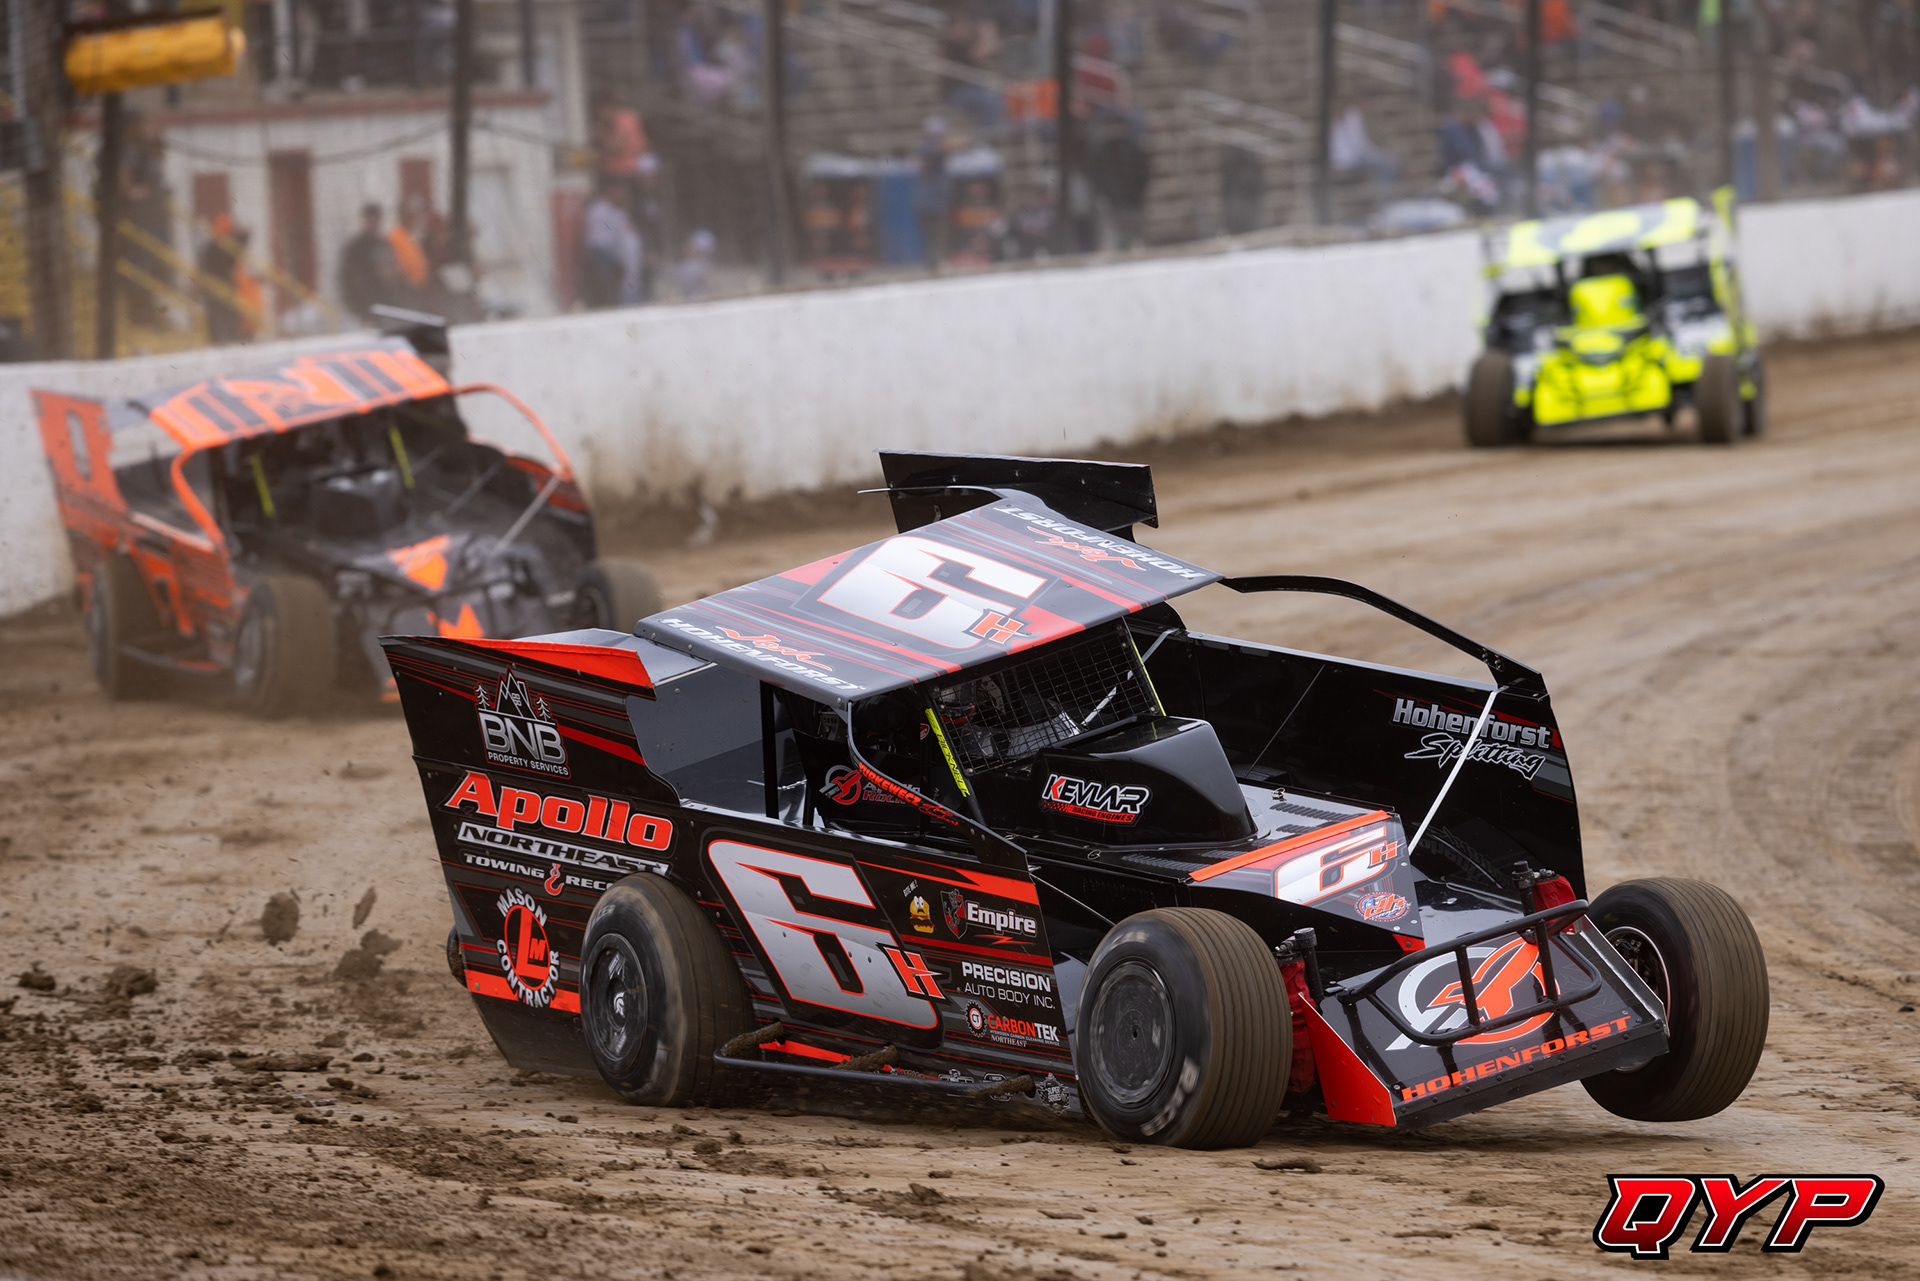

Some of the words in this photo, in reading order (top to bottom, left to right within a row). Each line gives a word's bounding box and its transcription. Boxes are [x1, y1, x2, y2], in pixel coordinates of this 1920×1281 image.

[993, 506, 1207, 579] HOHENFORST
[659, 618, 860, 691] HOHENFORST
[479, 713, 567, 765] BNB
[1392, 697, 1551, 749] Hohenforst
[487, 751, 528, 768] PROPERTY
[529, 760, 570, 777] SERVICES
[444, 769, 673, 851] Apollo
[1041, 773, 1150, 814] KEVLAR
[1072, 806, 1097, 818] RACING
[1097, 810, 1133, 822] ENGINES
[461, 825, 664, 874] NORTHEAST
[463, 852, 545, 879] TOWING
[496, 887, 548, 927] MASON
[966, 901, 1037, 935] Empire
[496, 939, 560, 1008] CONTRACTOR
[961, 961, 1052, 993] PRECISION
[964, 982, 996, 999] AUTO
[997, 988, 1031, 1005] BODY
[1033, 994, 1056, 1010] INC.
[987, 1014, 1060, 1042] CARBONTEK
[990, 1034, 1028, 1048] NORTHEAST
[1401, 1015, 1632, 1103] HOHENFORST
